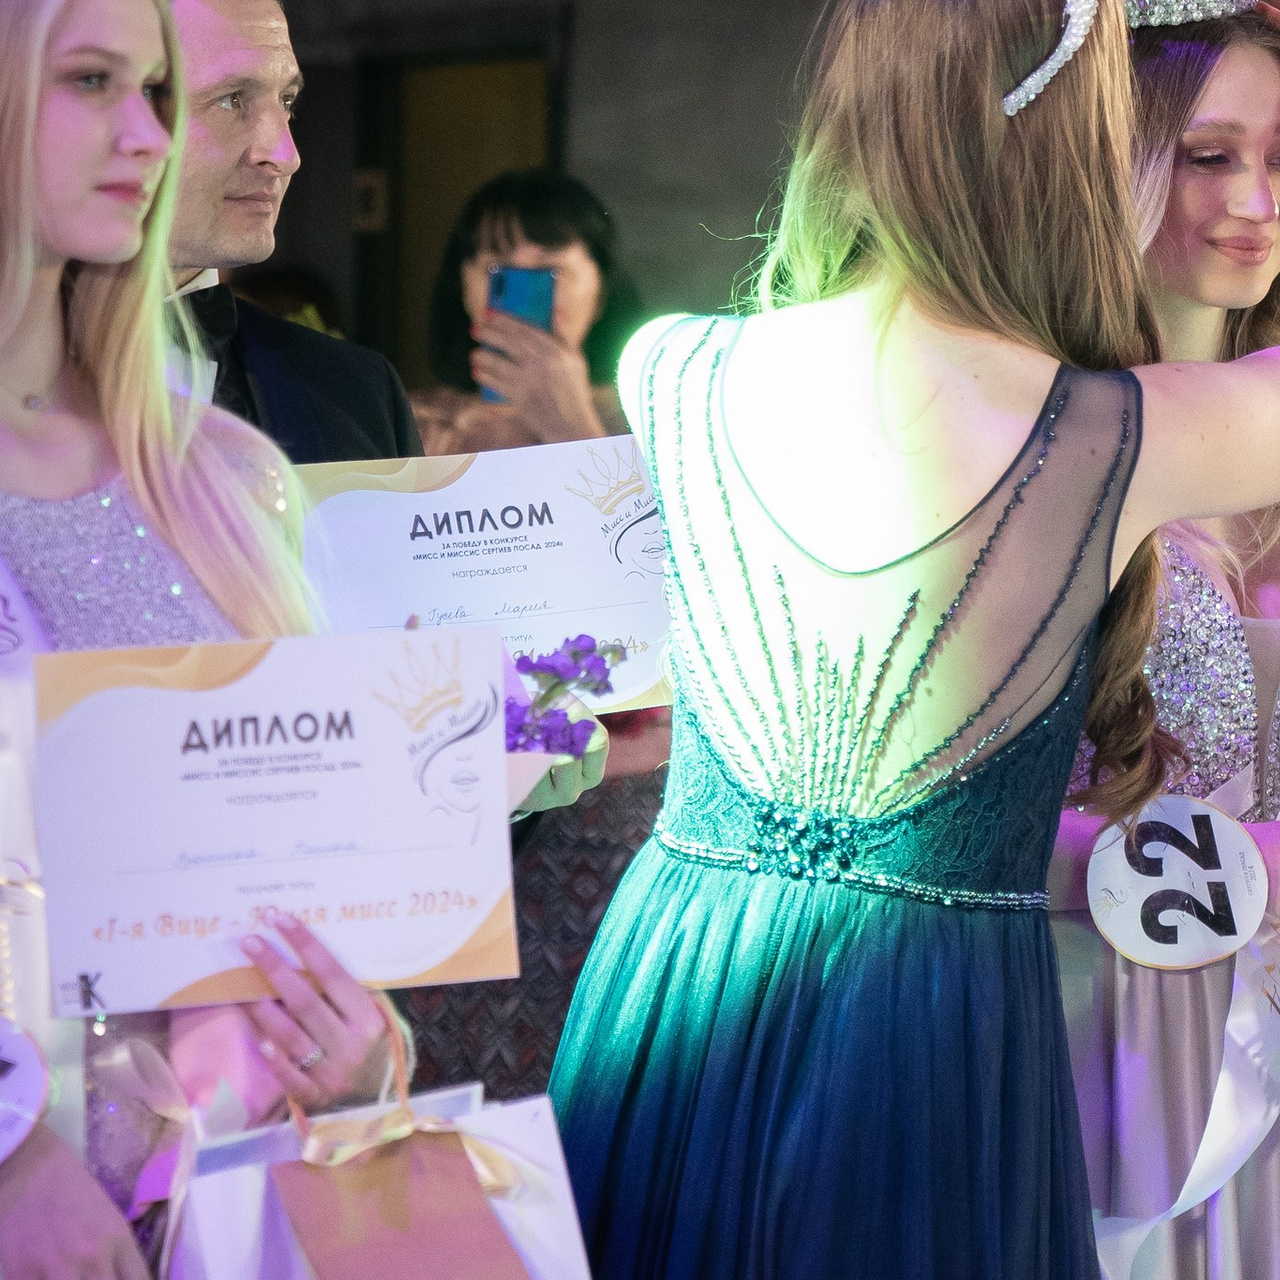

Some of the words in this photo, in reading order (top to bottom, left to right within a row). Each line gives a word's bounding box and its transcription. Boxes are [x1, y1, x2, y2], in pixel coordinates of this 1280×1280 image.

[410, 501, 554, 541] ДИПЛОМ
[601, 514, 624, 538] Мисс
[625, 510, 632, 518] и
[441, 542, 451, 550] ЗА
[452, 539, 482, 549] ПОБЕДУ
[489, 535, 528, 546] КОНКУРСЕ
[446, 549, 480, 558] МИССИС
[481, 546, 512, 556] СЕРГИЕВ
[513, 543, 542, 552] ПОСАД
[452, 564, 528, 579] награждается
[428, 606, 472, 625] Гусева
[495, 600, 555, 618] Мария
[180, 709, 354, 755] ДИПЛОМ
[1124, 814, 1238, 945] 22
[157, 912, 220, 939] Вице
[337, 899, 399, 923] мисс
[407, 889, 479, 917] 2024»
